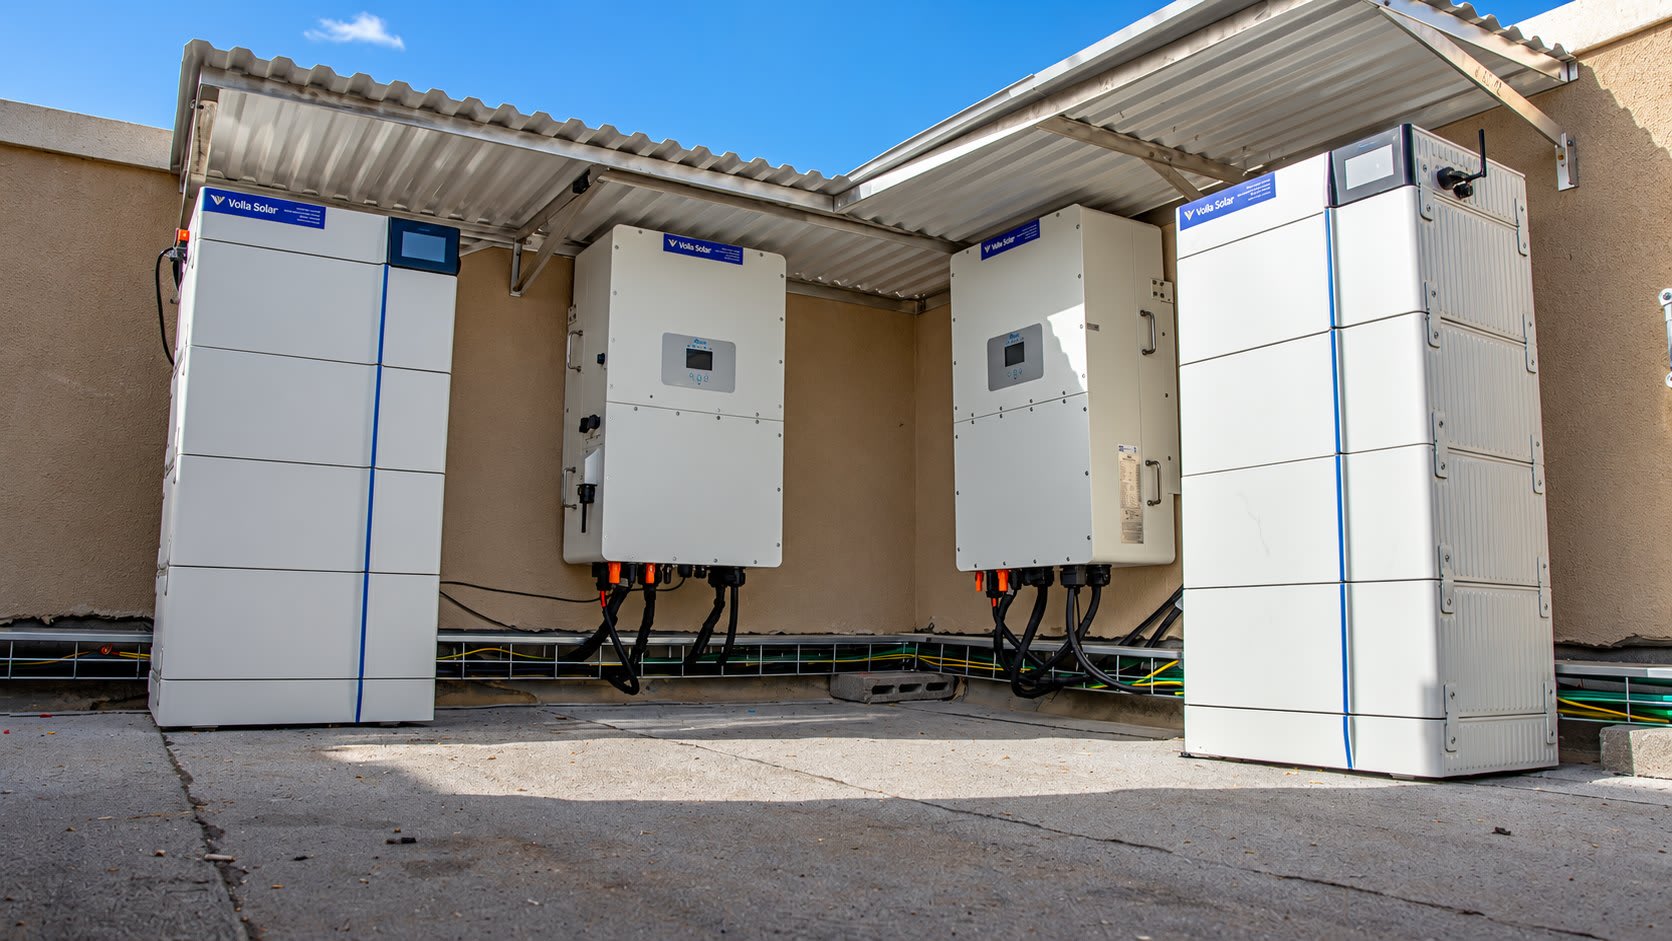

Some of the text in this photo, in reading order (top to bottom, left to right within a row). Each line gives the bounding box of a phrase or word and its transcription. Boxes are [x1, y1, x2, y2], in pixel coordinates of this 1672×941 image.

[228, 198, 251, 211] Volla
[253, 203, 279, 215] Solar
[1215, 196, 1234, 210] Solar
